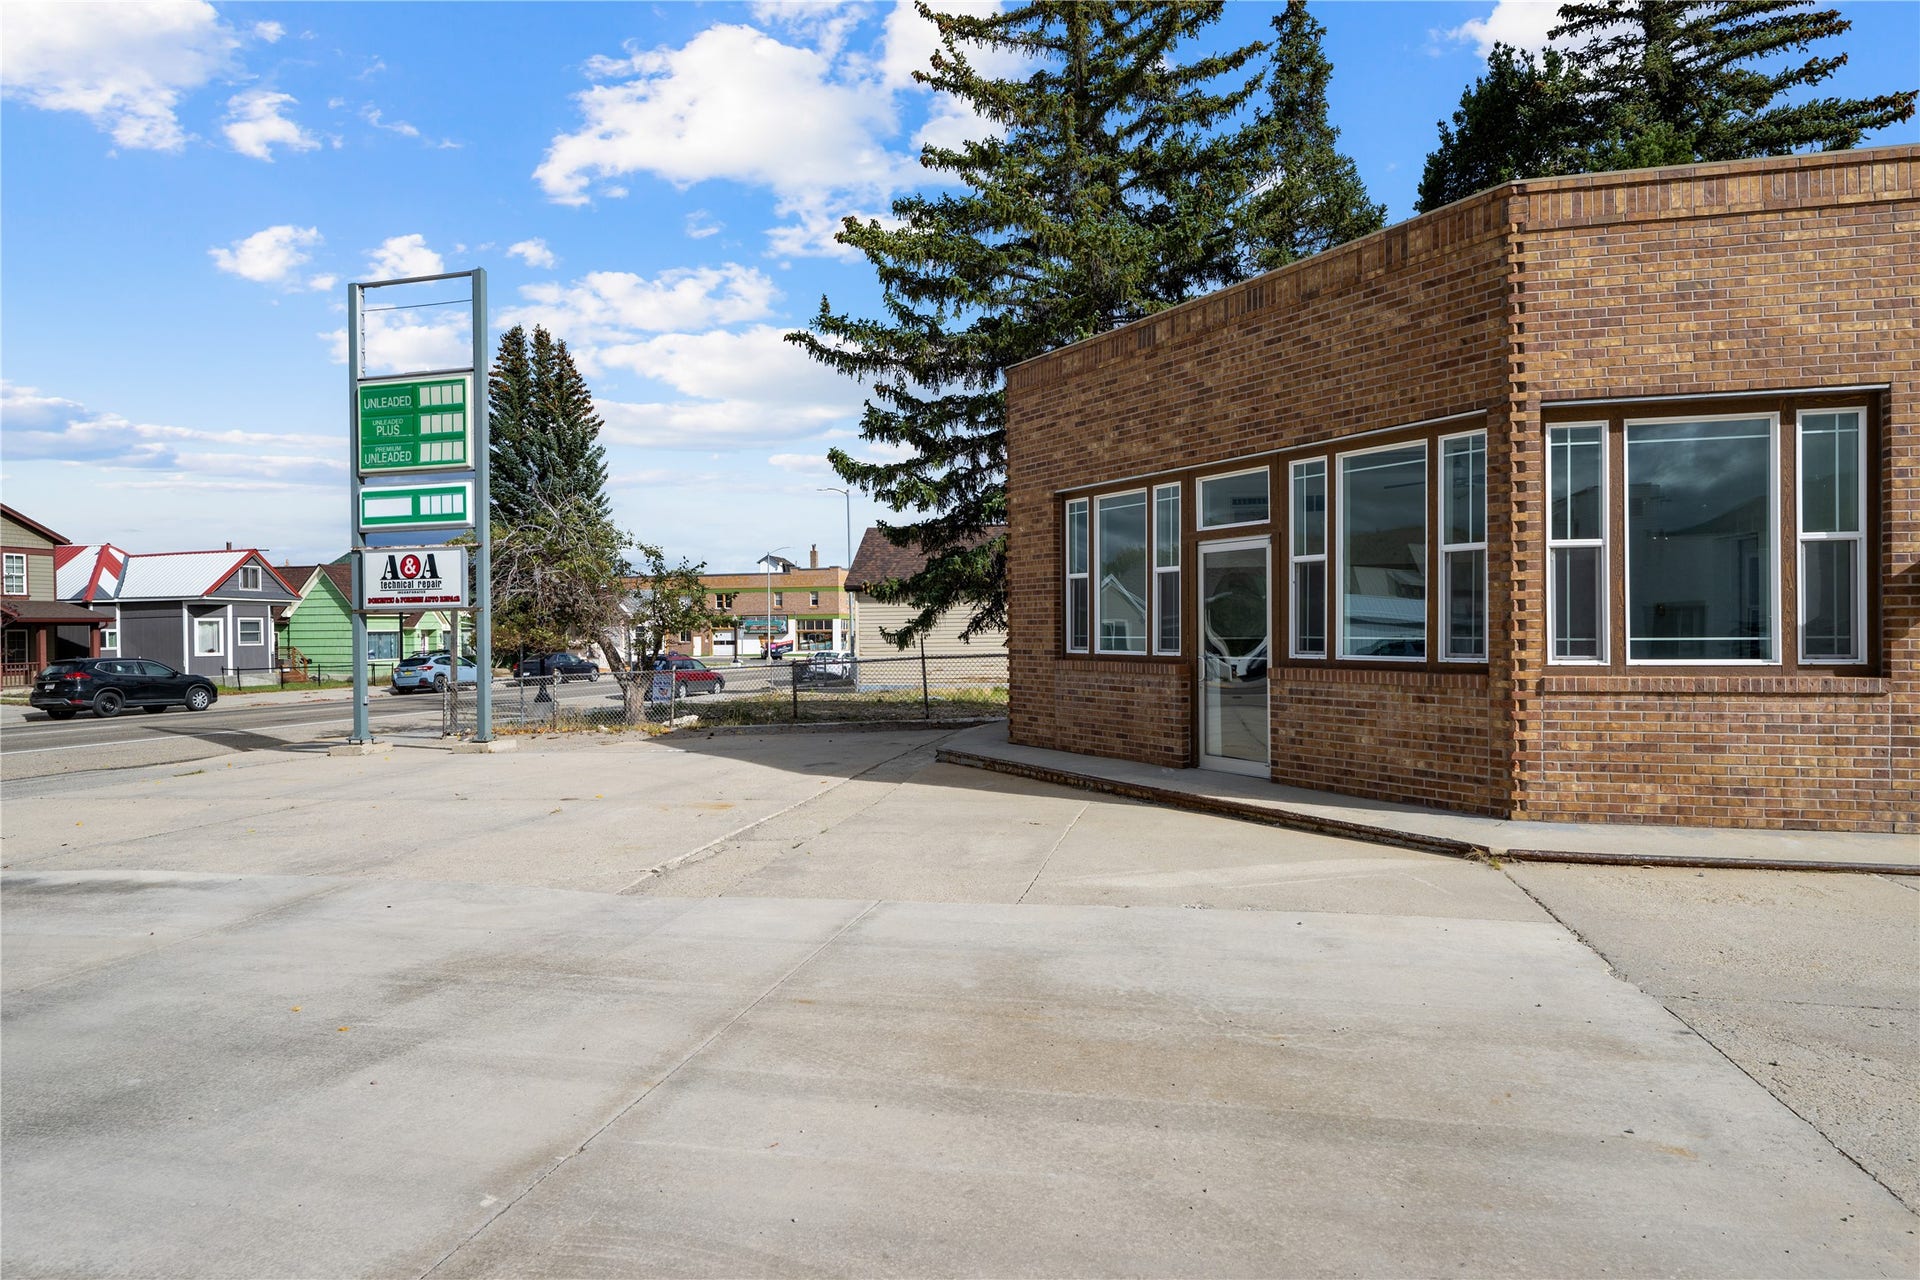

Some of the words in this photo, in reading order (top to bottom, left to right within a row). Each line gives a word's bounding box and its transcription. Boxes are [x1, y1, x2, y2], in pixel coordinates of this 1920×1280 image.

[363, 395, 412, 410] UNLEADED
[372, 418, 404, 426] UNLEADED
[376, 424, 400, 436] PLUS
[374, 445, 402, 453] PREMIUM
[364, 450, 412, 465] UNLEADED
[380, 553, 442, 580] A&A
[380, 580, 414, 590] technical
[417, 579, 442, 589] repair
